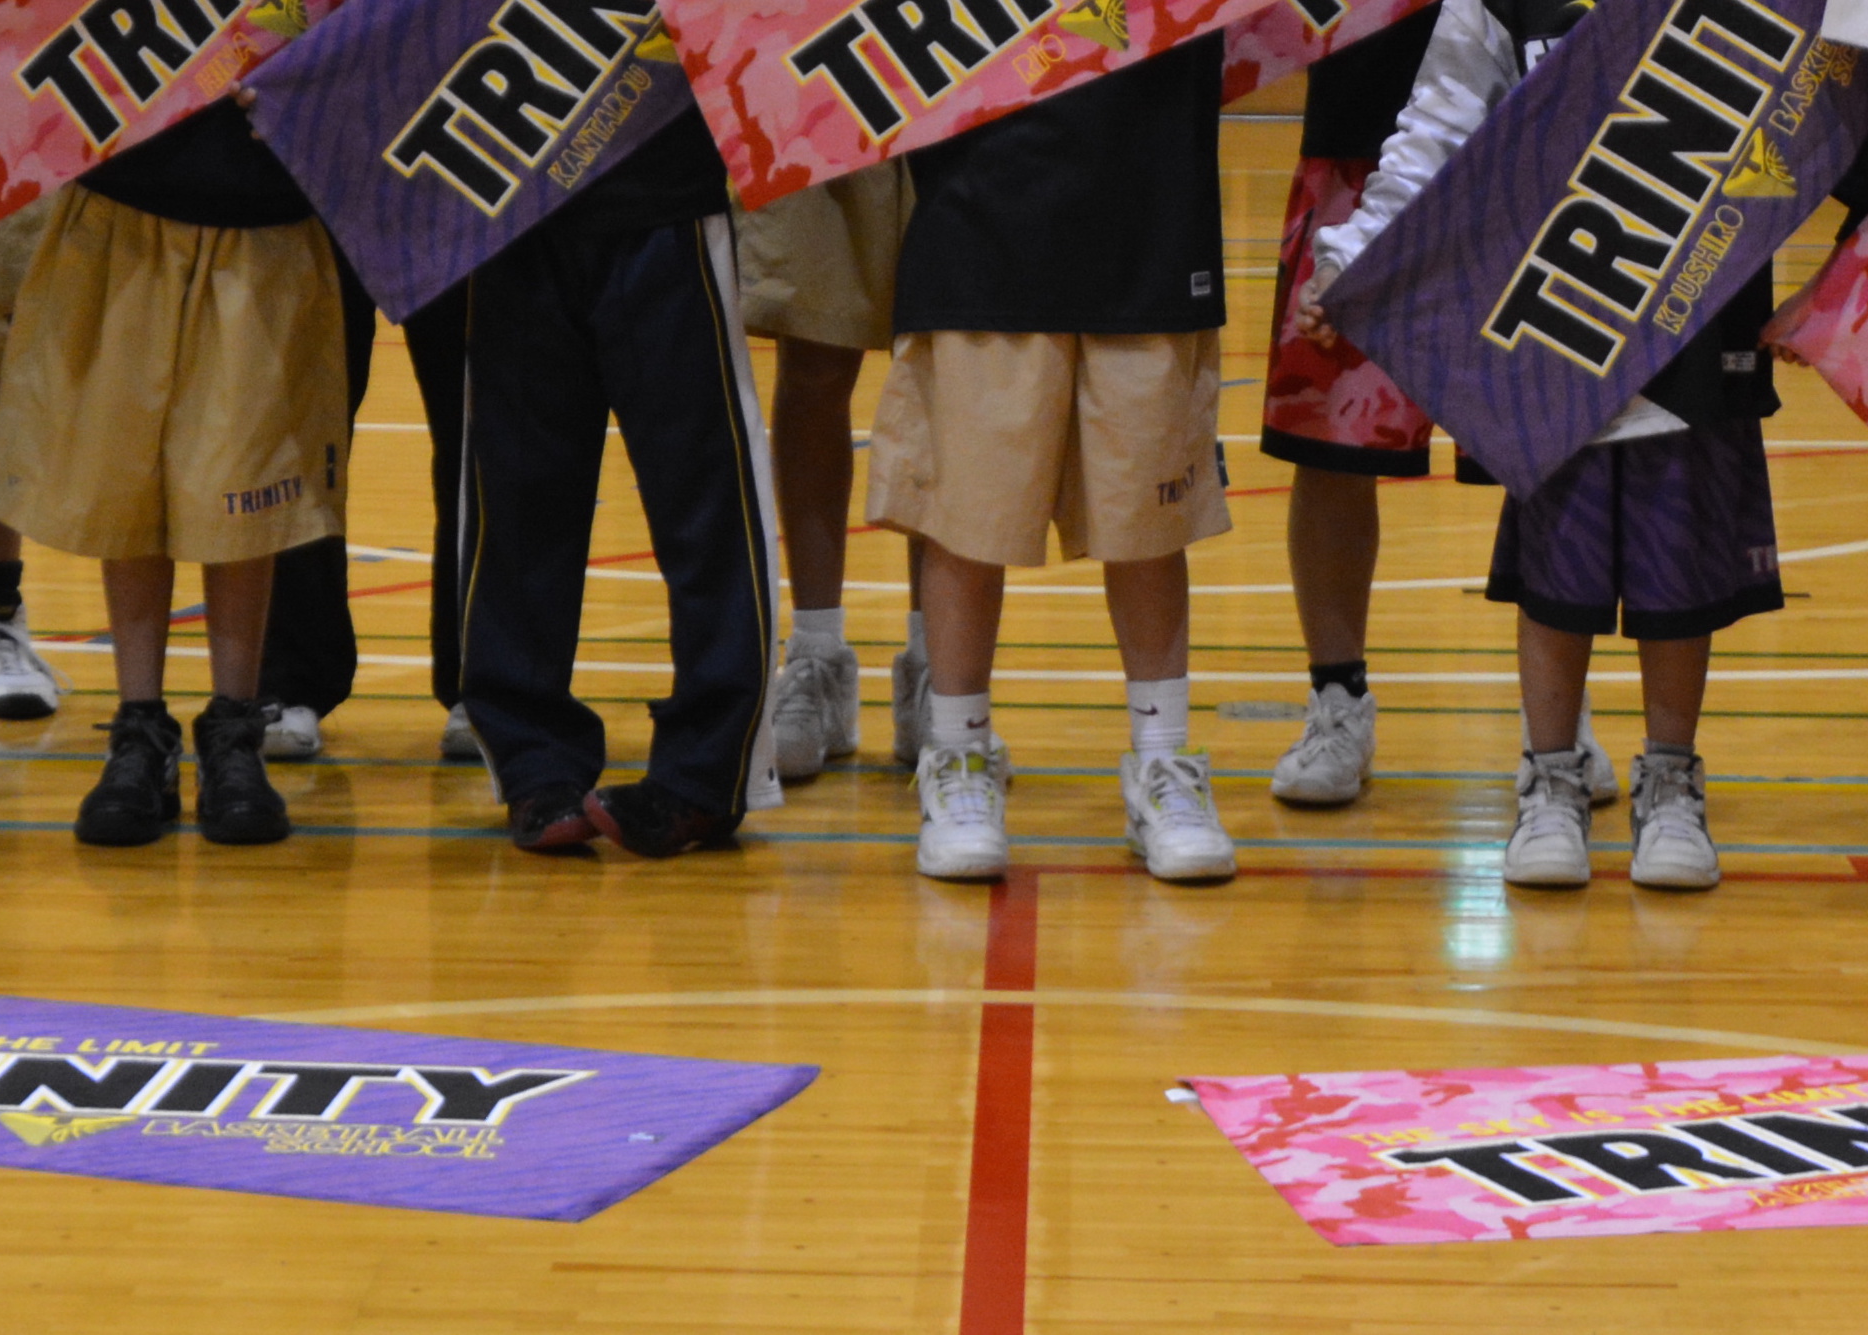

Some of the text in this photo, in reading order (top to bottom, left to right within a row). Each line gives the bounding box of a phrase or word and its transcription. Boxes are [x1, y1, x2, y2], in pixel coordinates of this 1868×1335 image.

[1011, 33, 1068, 86] RIO
[547, 63, 654, 191] KANTAROU
[1651, 203, 1745, 336] KOUSHIRO
[222, 474, 304, 515] TRINITY
[77, 1037, 220, 1057] LIMIT
[141, 1118, 507, 1147] BASKETBALL
[1457, 1113, 1551, 1139] SKY
[1568, 1108, 1627, 1126] IS
[1636, 1097, 1743, 1120] THE
[263, 1136, 499, 1160] SCHOOL
